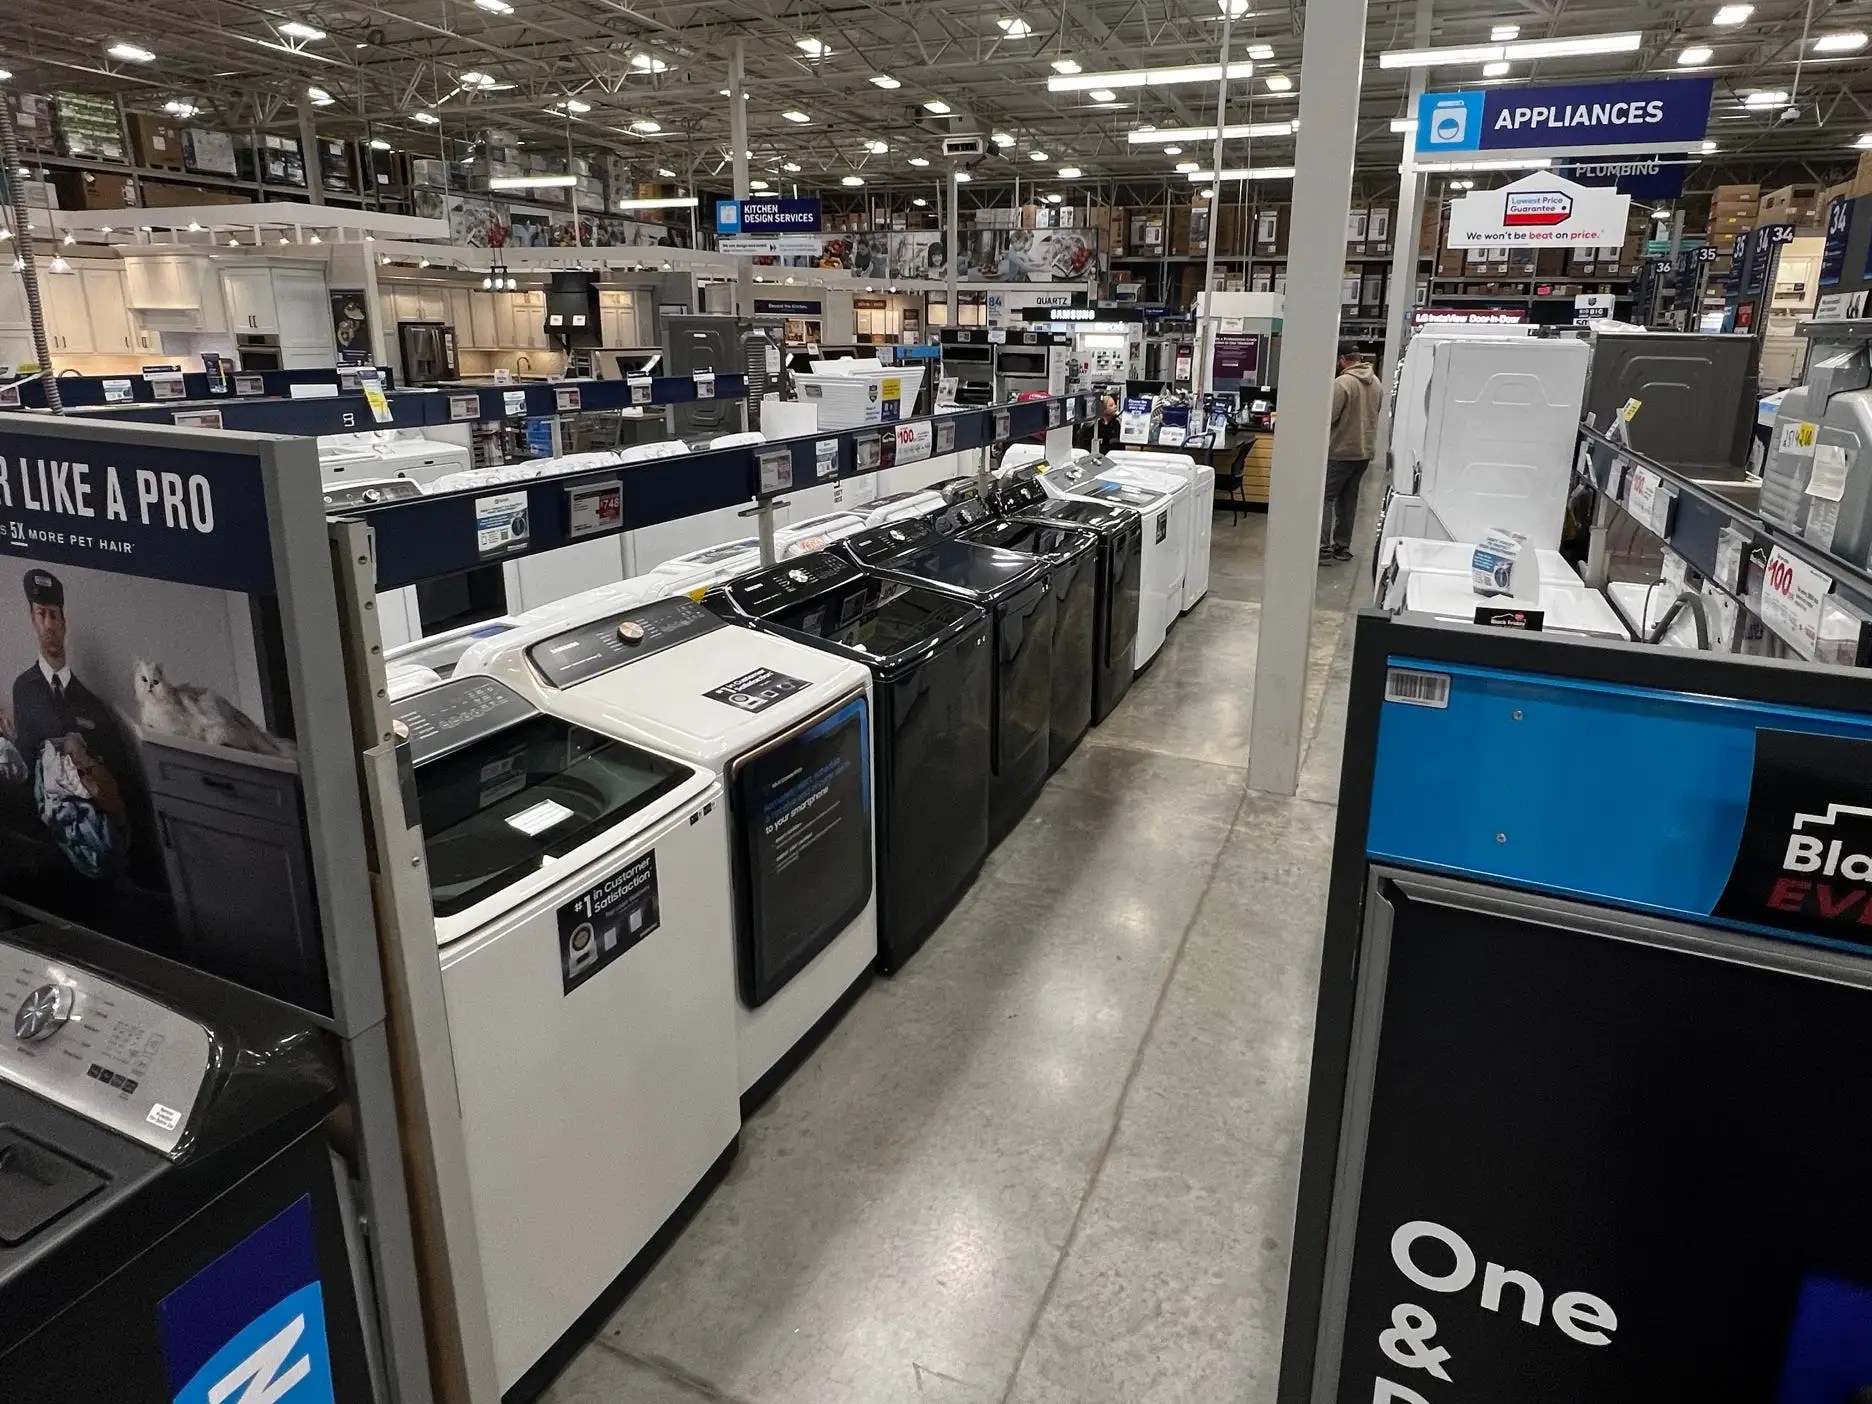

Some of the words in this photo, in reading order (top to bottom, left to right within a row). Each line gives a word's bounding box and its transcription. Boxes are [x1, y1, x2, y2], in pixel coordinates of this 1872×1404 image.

[1494, 100, 1664, 130] APPLIANCES
[1575, 160, 1660, 178] PLUMBING
[744, 204, 778, 214] KITCHEN
[1510, 205, 1556, 213] Guarantee
[1511, 196, 1541, 205] Lowest
[1542, 196, 1563, 204] Price
[744, 213, 774, 223] DESIGN
[775, 213, 814, 223] SERVICES
[1830, 200, 1848, 235] 34
[1466, 232, 1482, 240] We
[1484, 231, 1512, 240] won't
[1514, 231, 1527, 240] be
[1529, 230, 1553, 240] beat
[1555, 232, 1569, 240] on
[1773, 226, 1794, 242] 34
[1699, 248, 1717, 261] 35
[1656, 262, 1672, 273] 36
[1036, 297, 1068, 306] QUARTZ
[1050, 309, 1096, 321] SAMSUNG
[19, 457, 95, 517] LIKE
[106, 466, 128, 522] A
[135, 469, 214, 534] PRO
[10, 521, 26, 541] 5X
[28, 528, 65, 544] MORE
[70, 535, 93, 548] PET
[765, 825, 774, 834] to
[774, 813, 790, 831] your
[790, 785, 829, 818] smartphone
[574, 894, 592, 918] #1
[593, 887, 603, 900] in
[604, 857, 651, 893] Customer
[594, 868, 653, 913] Satisfaction
[1391, 1220, 1618, 1346] One
[1378, 1303, 1454, 1384] &
